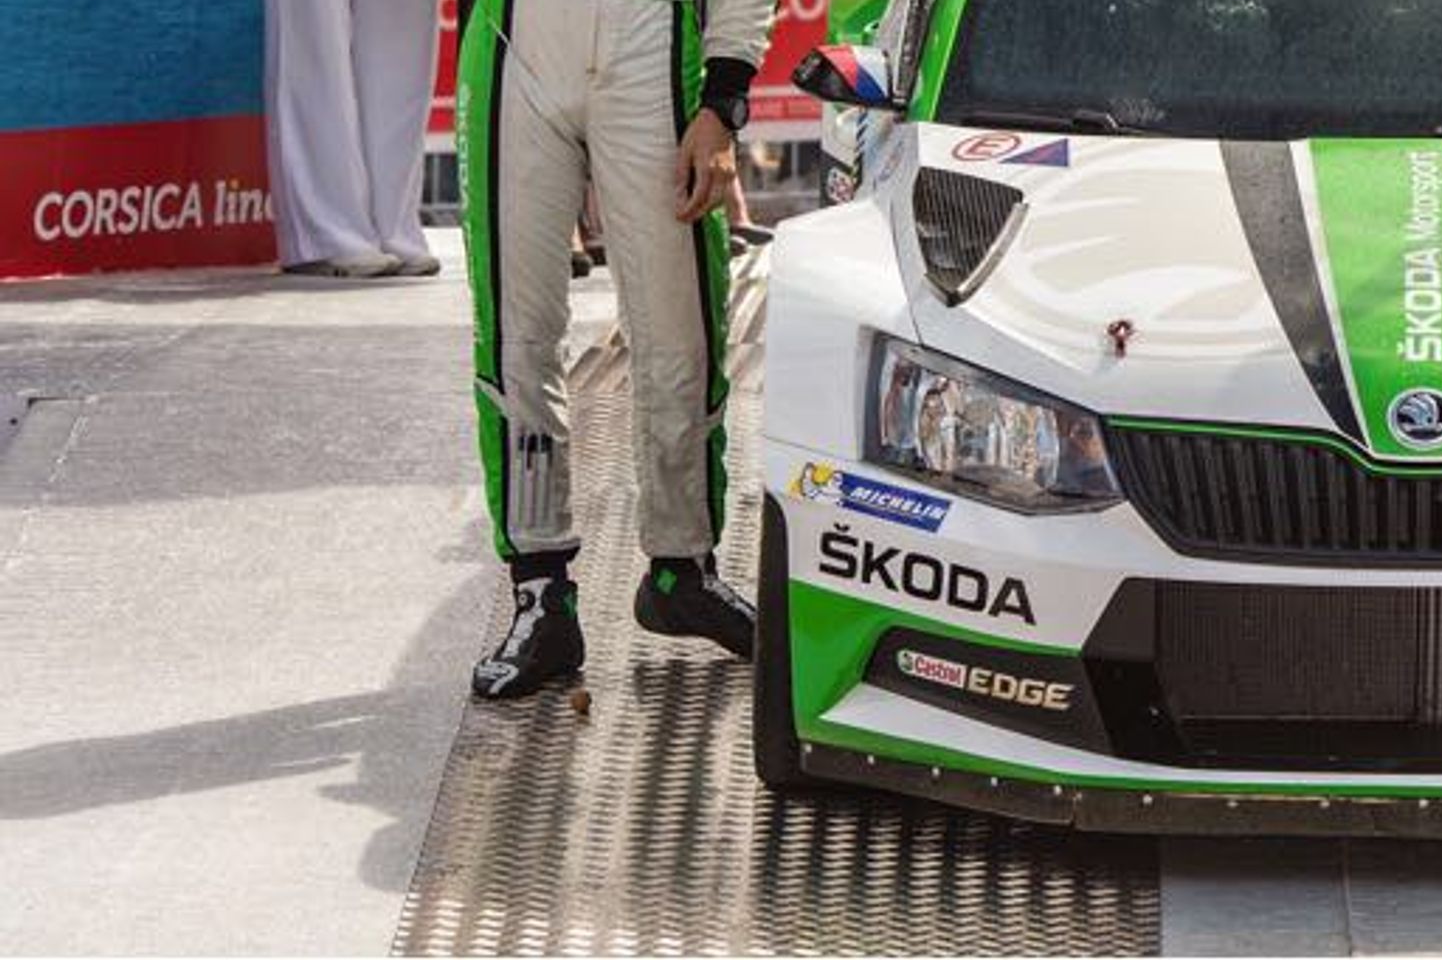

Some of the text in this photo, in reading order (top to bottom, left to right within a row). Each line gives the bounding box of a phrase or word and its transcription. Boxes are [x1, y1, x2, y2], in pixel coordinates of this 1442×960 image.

[34, 182, 203, 241] CORSICA
[1397, 247, 1442, 362] ŠKODA
[850, 485, 944, 520] MICHELIN
[818, 523, 1037, 626] ŠKODA
[914, 655, 1075, 711] Castrol EDGE
